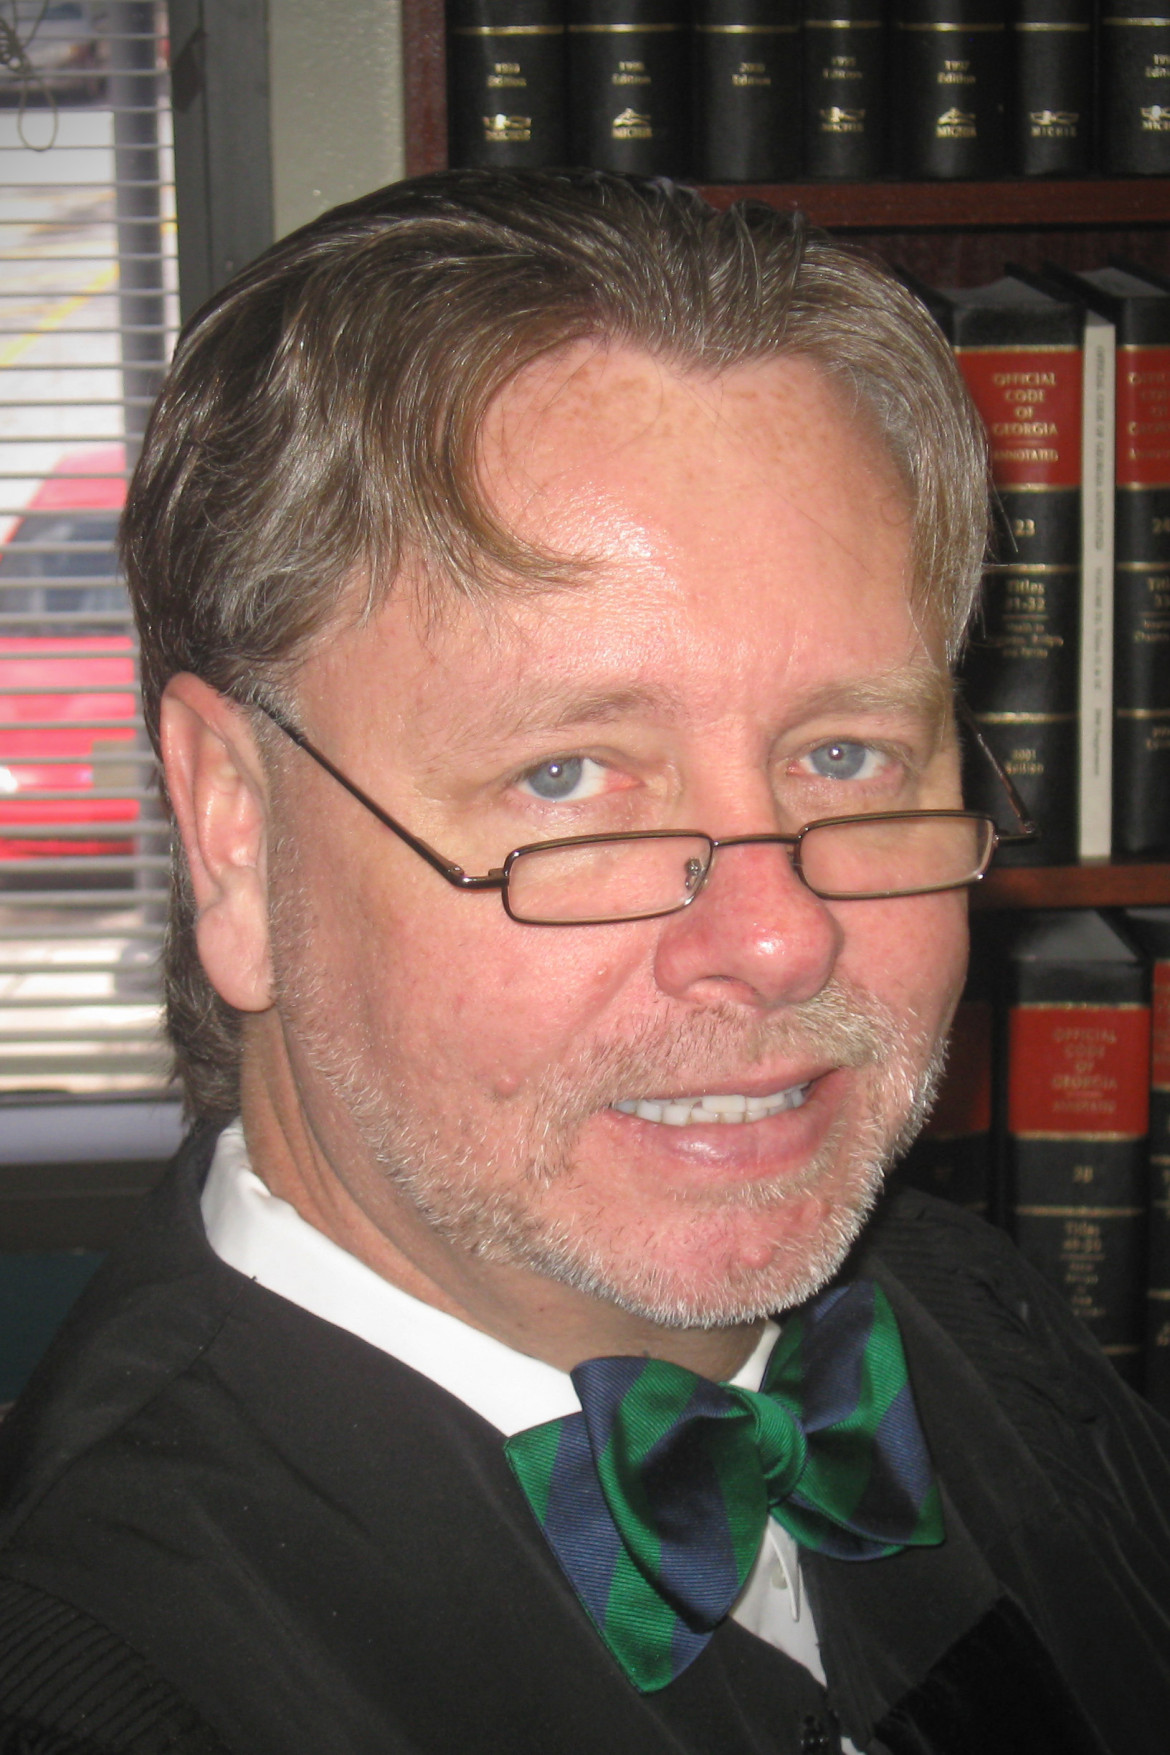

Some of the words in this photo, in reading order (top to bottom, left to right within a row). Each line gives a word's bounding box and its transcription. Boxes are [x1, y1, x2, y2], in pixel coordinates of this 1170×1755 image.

[1030, 126, 1079, 138] MICHIE
[993, 371, 1057, 386] OFFICIAL
[1005, 389, 1047, 403] CODE
[1014, 406, 1034, 420] OF
[992, 422, 1059, 436] GEORGIA
[1014, 518, 1036, 537] 23
[1006, 579, 1045, 596] Titles
